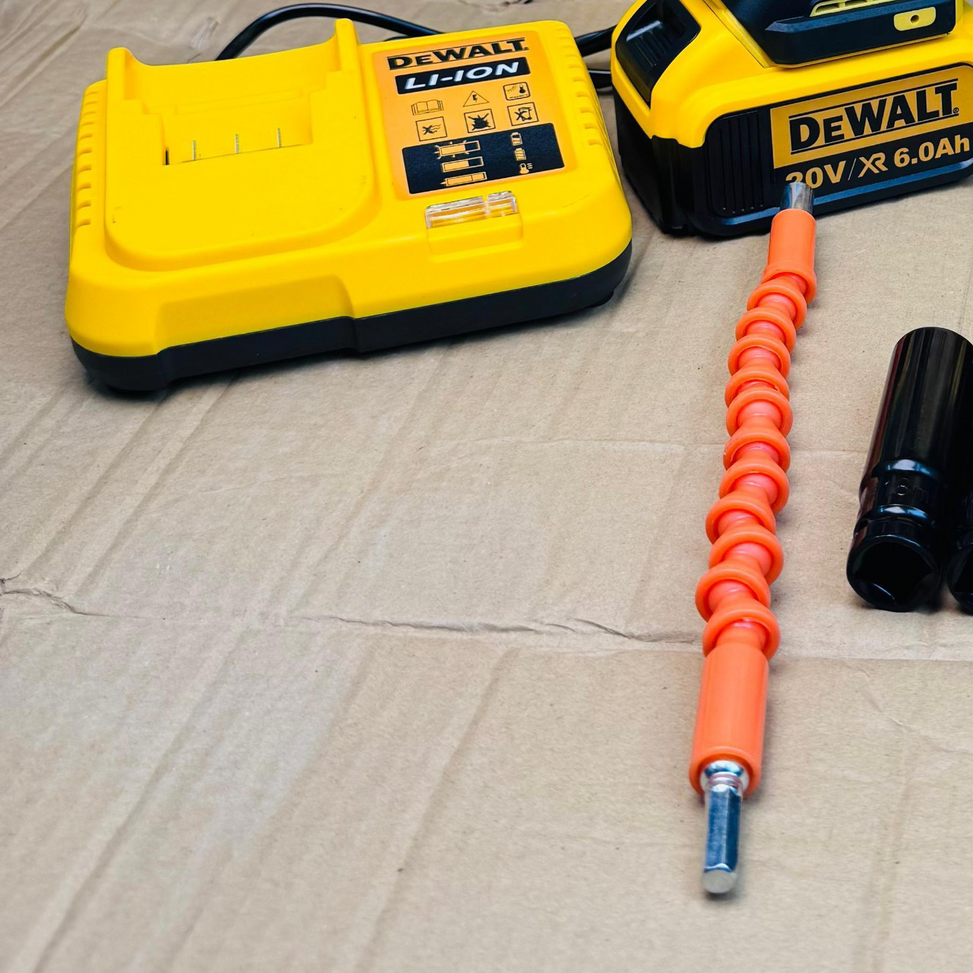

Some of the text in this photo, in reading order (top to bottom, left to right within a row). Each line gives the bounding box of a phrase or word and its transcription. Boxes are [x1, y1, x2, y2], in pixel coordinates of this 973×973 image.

[387, 38, 526, 70] DEWALT
[403, 61, 520, 90] LI-ION
[788, 83, 958, 152] DEWALT
[893, 134, 971, 168] 6.0Ah
